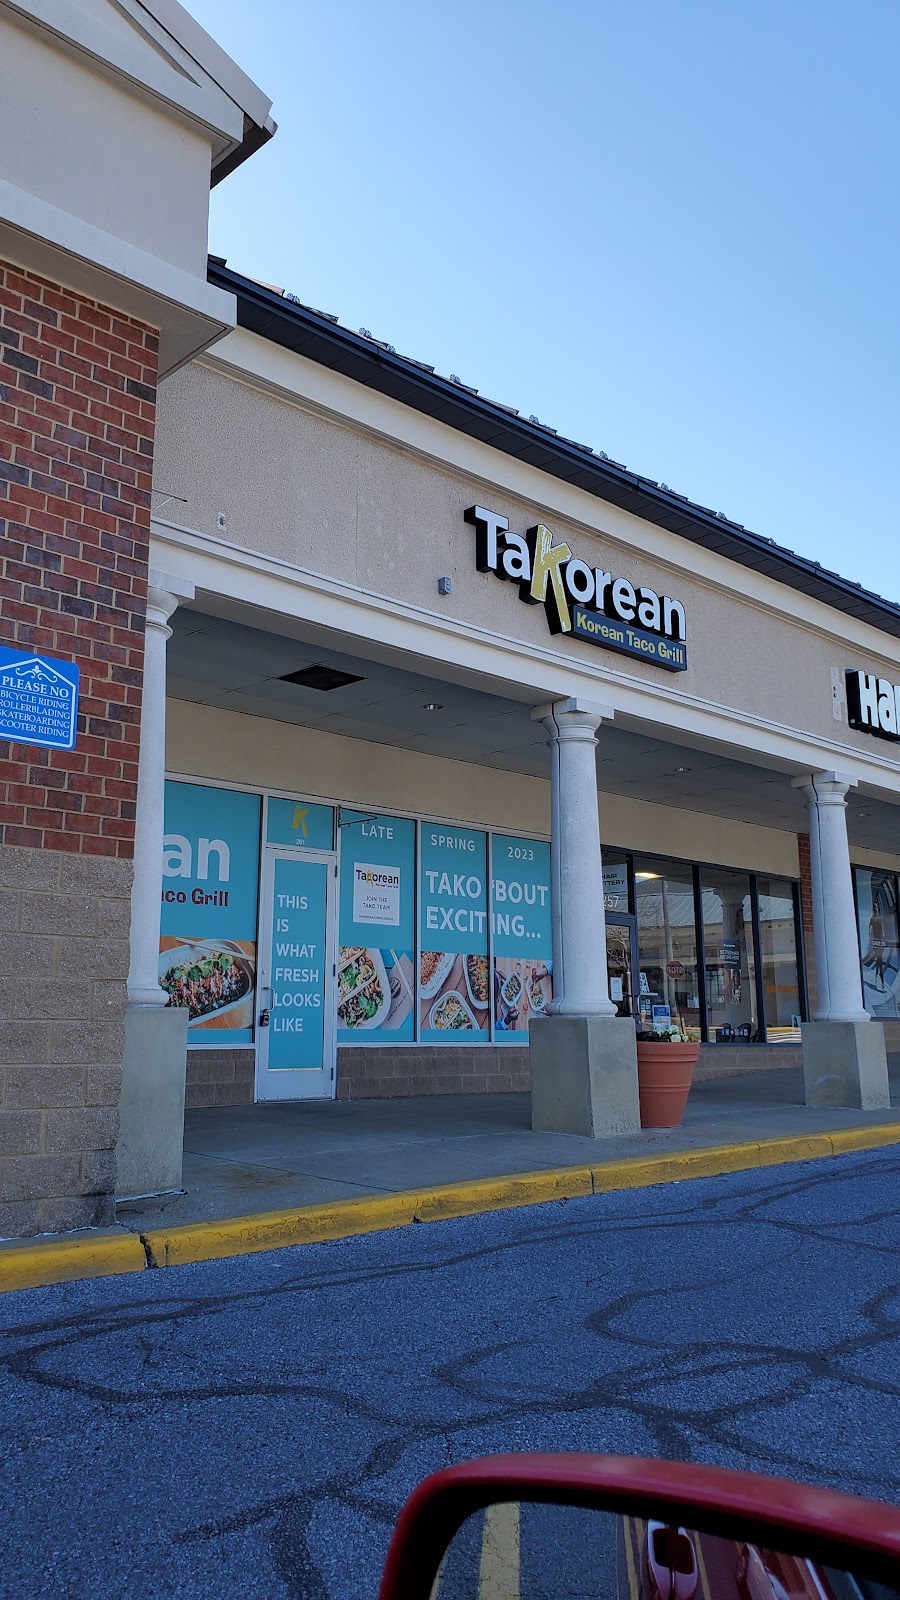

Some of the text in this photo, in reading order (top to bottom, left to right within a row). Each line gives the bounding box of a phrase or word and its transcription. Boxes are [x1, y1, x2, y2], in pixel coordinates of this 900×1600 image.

[576, 611, 683, 664] Korean Taco Grill
[2, 675, 69, 698] PLEASE NO
[1, 690, 69, 710] BICYCLE RIDING
[0, 709, 70, 729] KATEBOARDING
[0, 719, 70, 738] COOTER RIDING
[361, 823, 394, 840] LATE
[430, 834, 475, 851] SPRING
[507, 846, 534, 861] 2023
[425, 870, 481, 898] TAKO
[191, 887, 229, 907] Grill
[277, 894, 308, 910] THIS
[276, 918, 289, 933] IS
[276, 943, 316, 958] WHAT
[275, 967, 319, 983] FRESH
[274, 992, 321, 1008] LOOKS
[273, 1017, 304, 1032] LIKE
